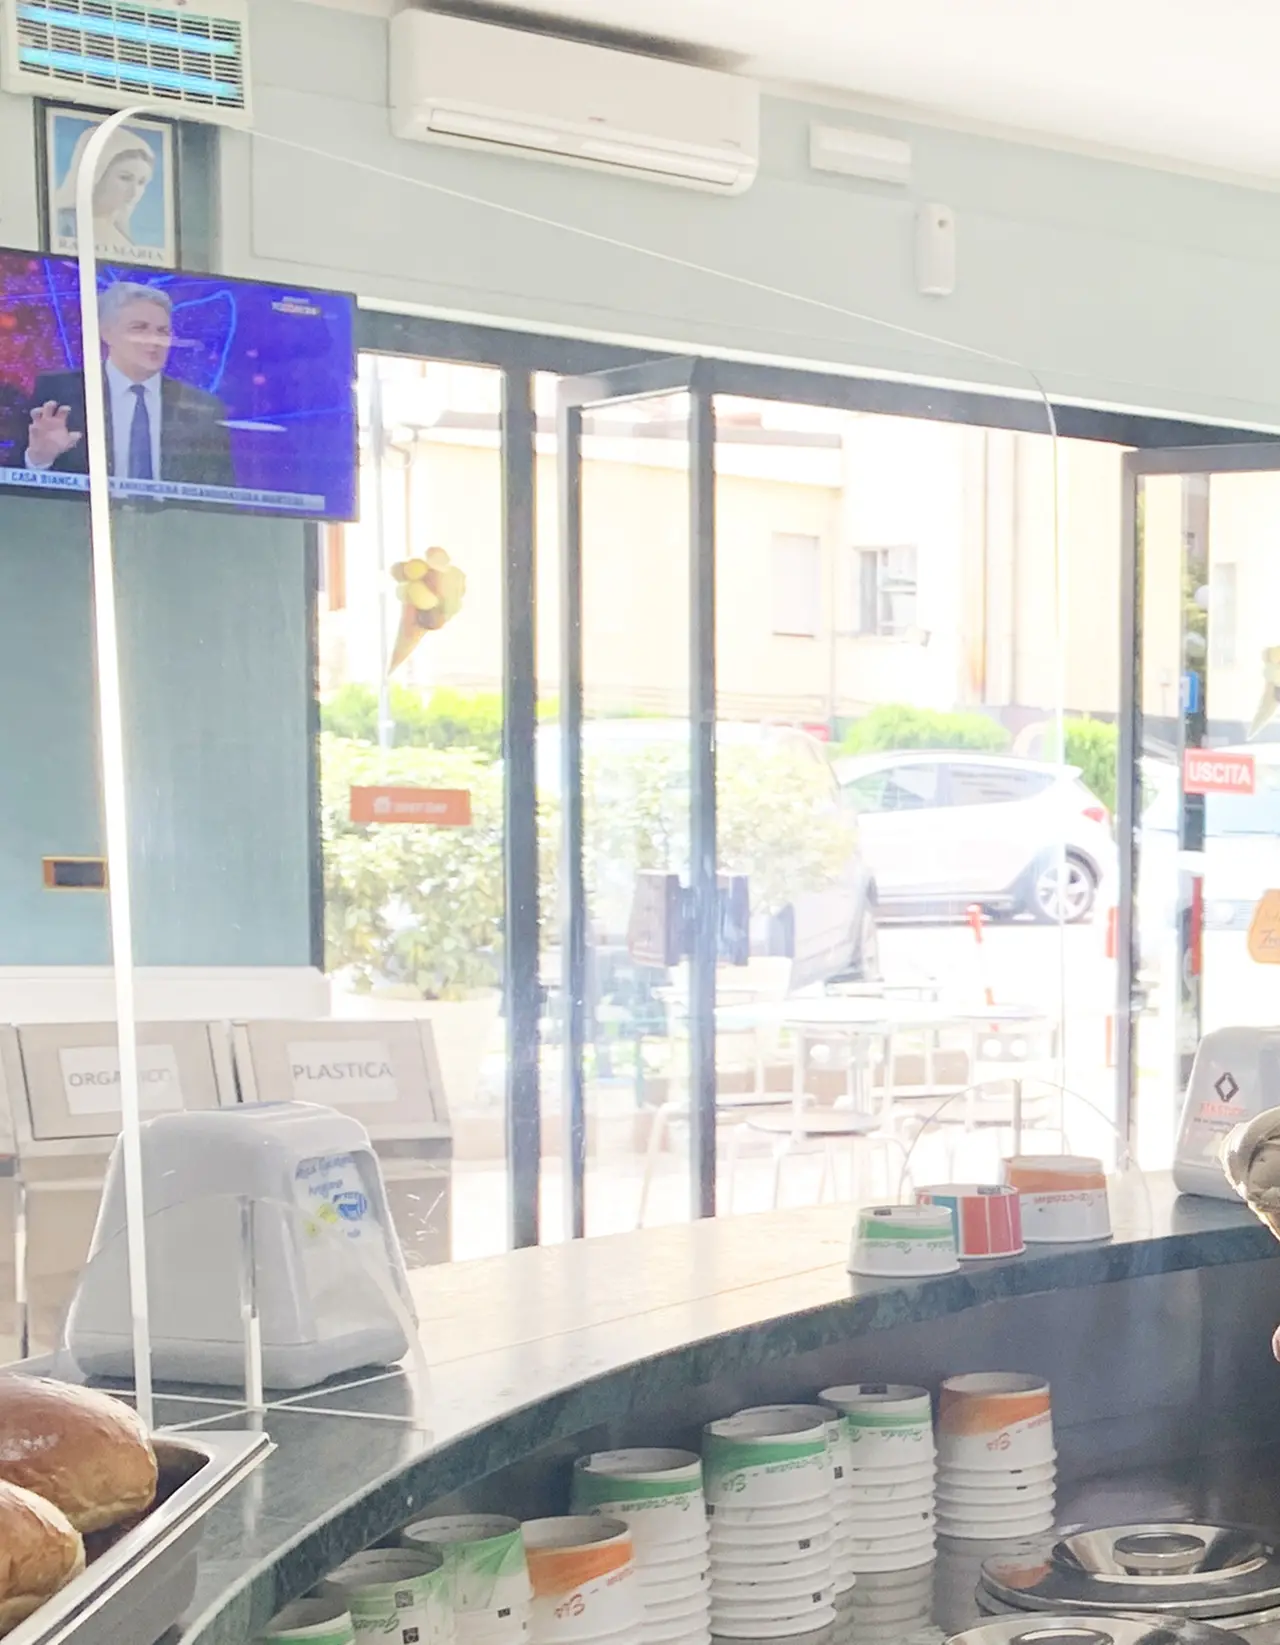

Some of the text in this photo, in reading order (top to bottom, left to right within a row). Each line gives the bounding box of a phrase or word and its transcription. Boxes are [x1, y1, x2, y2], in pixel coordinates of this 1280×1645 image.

[11, 471, 37, 484] CASA
[1189, 761, 1251, 785] USCITA
[292, 1061, 394, 1081] PLASTICA
